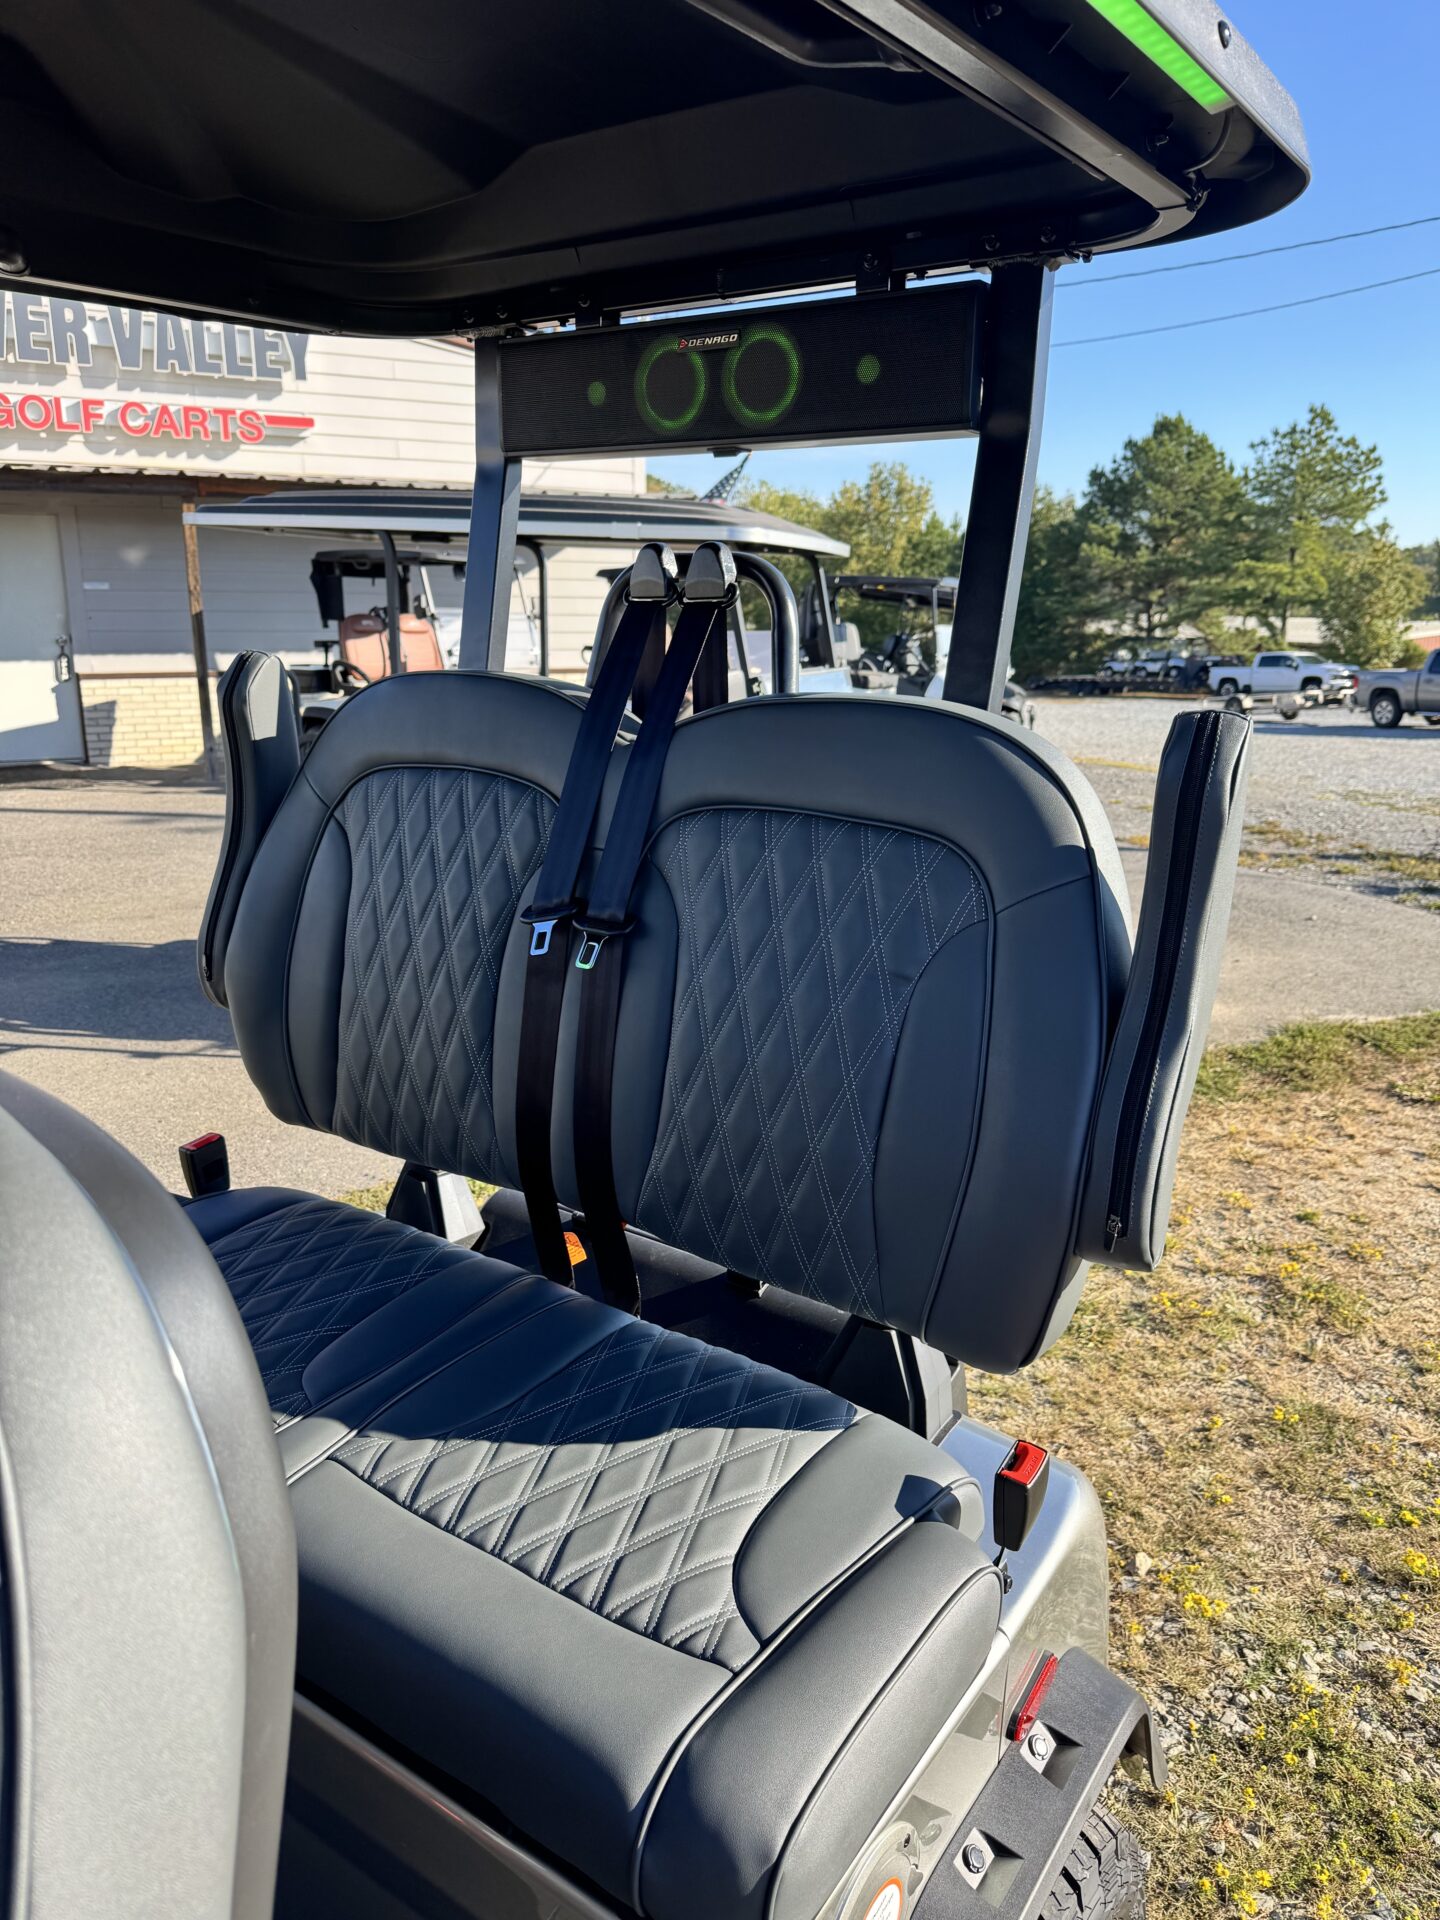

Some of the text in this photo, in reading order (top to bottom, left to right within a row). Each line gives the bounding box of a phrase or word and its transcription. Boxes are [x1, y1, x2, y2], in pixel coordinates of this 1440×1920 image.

[0, 291, 310, 381] ER VALLEY
[688, 333, 738, 346] DENAGO
[117, 400, 266, 443] CARTS
